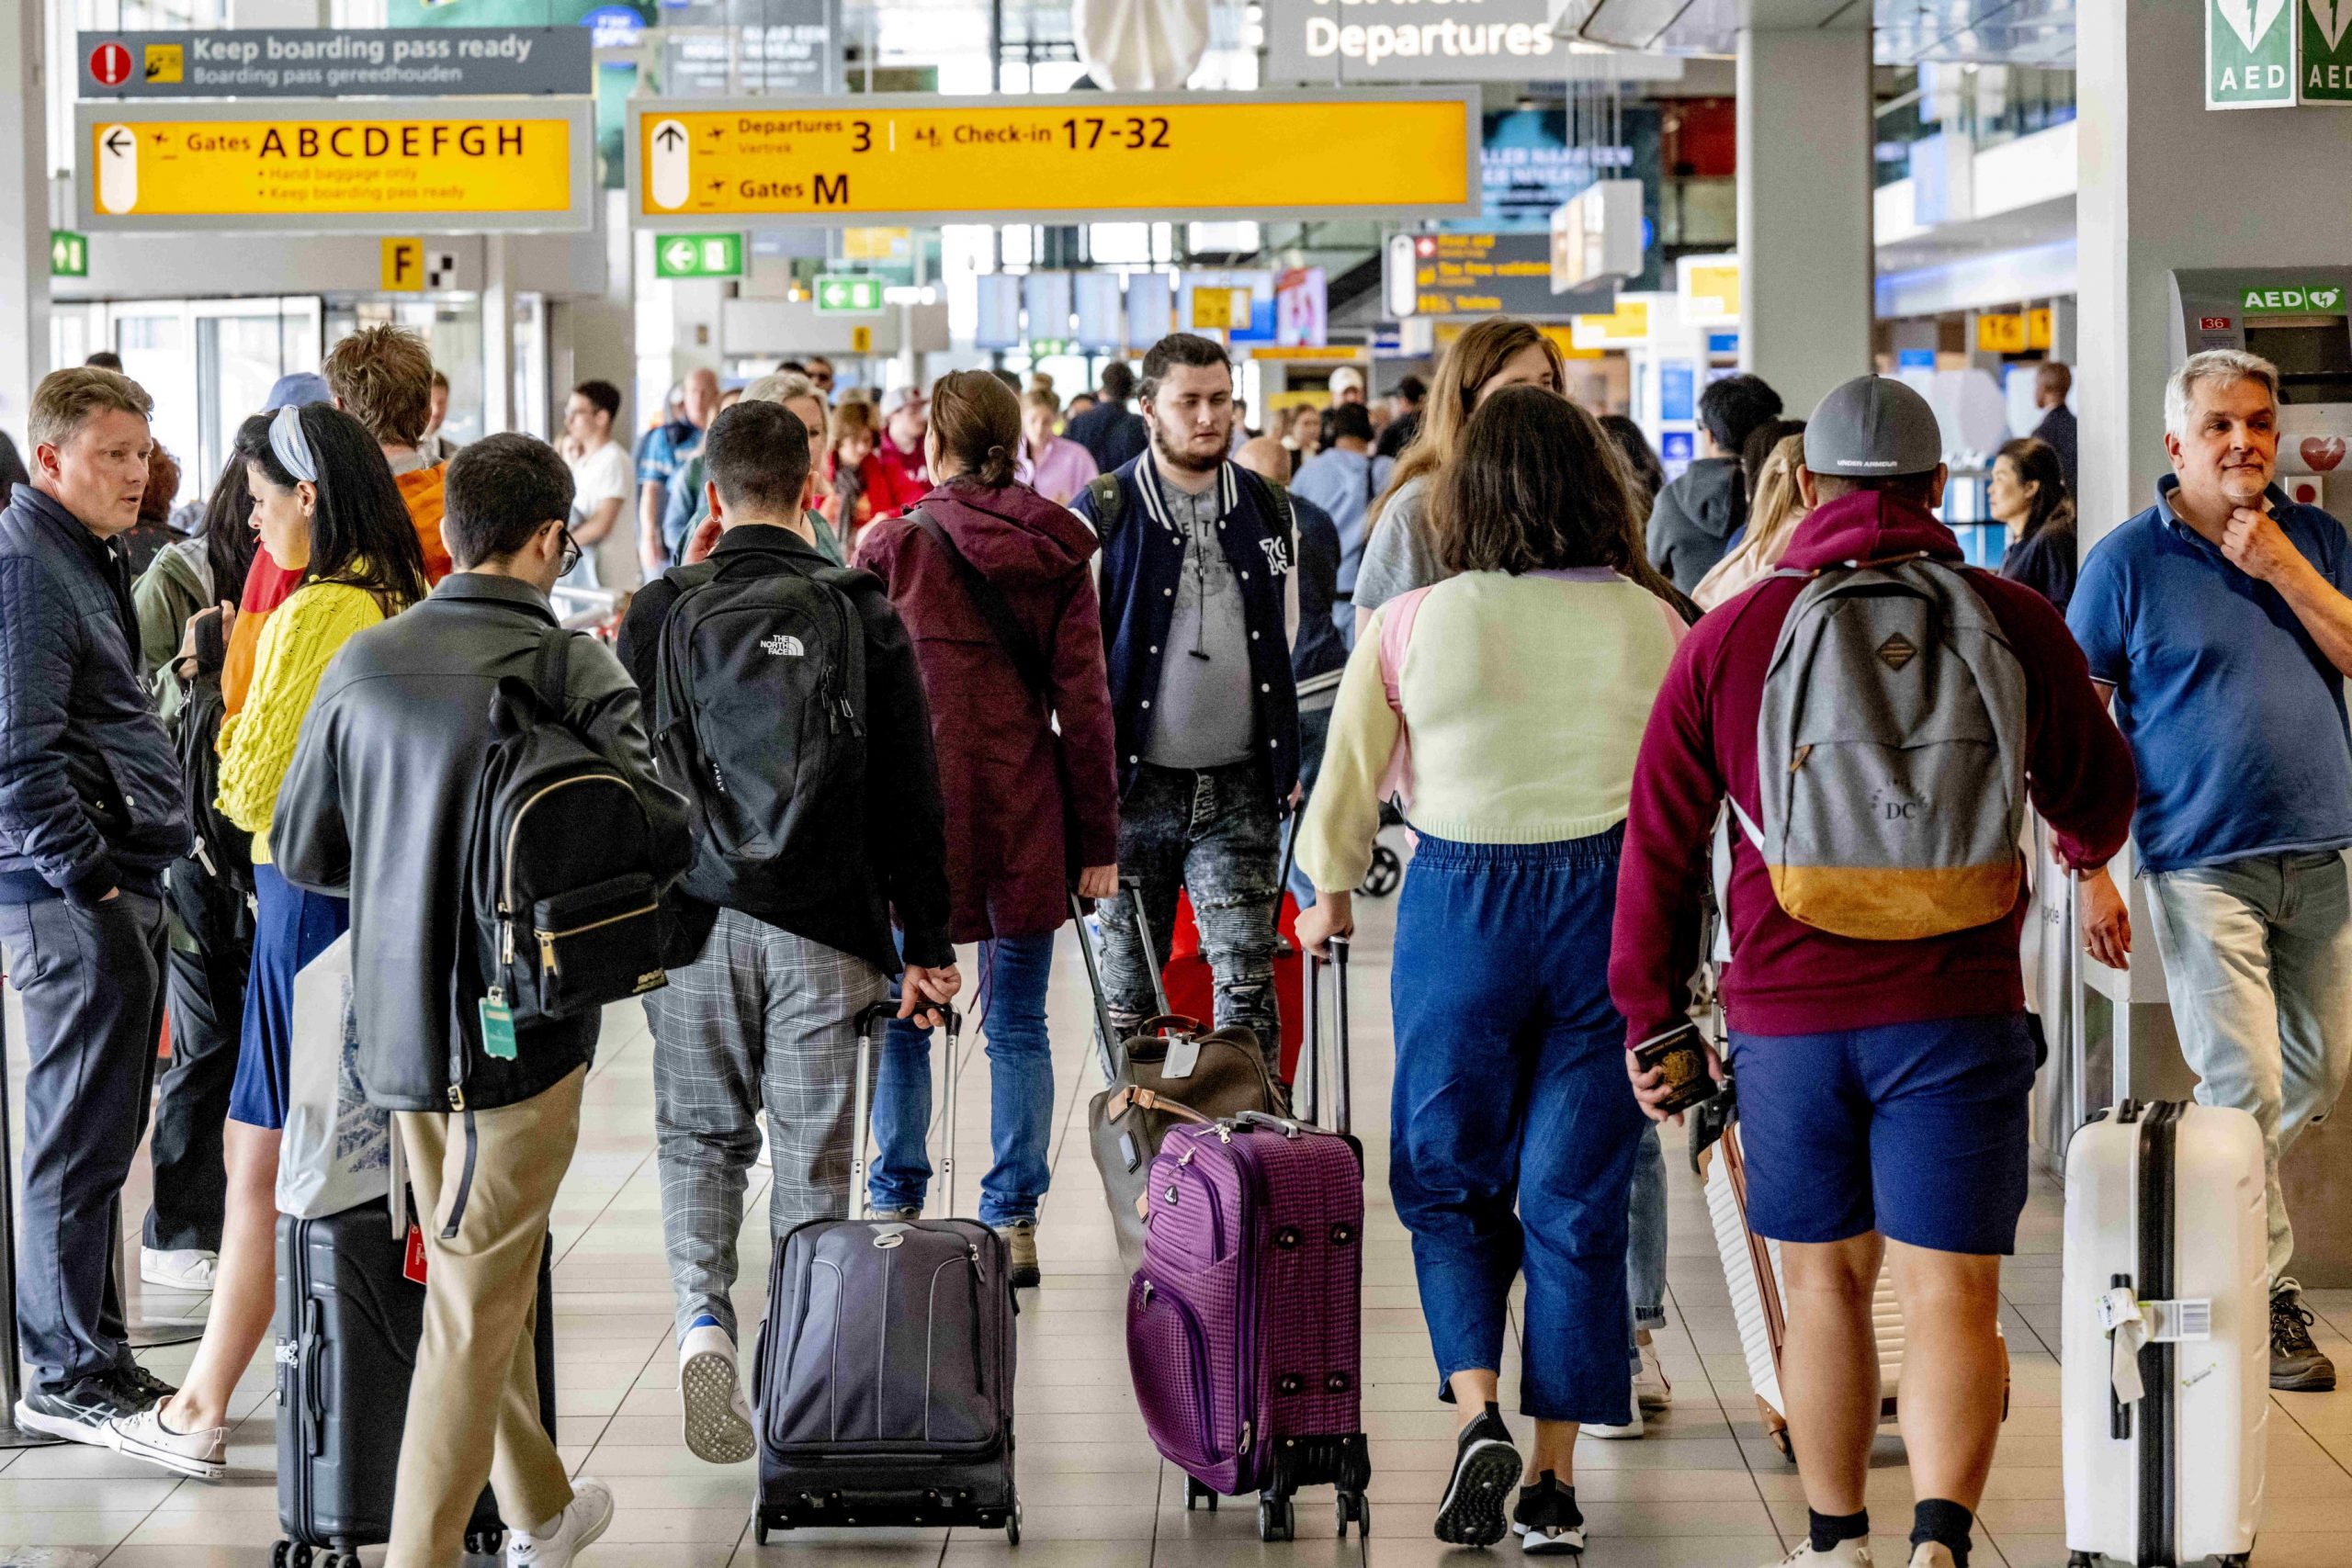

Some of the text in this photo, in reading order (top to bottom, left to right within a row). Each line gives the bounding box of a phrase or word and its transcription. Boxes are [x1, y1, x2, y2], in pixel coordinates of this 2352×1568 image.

[193, 33, 533, 64] Keep boarding pass ready
[1305, 17, 1554, 66] Departures
[194, 64, 462, 88] Boarding pass gereedhouden
[2219, 64, 2285, 91] AED
[187, 132, 252, 152] Gates
[737, 118, 871, 152] Departures 3
[953, 117, 1170, 149] Check-in 17-32
[270, 165, 418, 184] Hand baggage only
[270, 185, 466, 204] Keep boarding pass ready
[740, 174, 848, 205] Gates M
[395, 245, 412, 283] F
[2245, 291, 2303, 309] AED
[2205, 318, 2224, 329] 36
[1838, 459, 1863, 468] UNDER
[760, 640, 788, 649] NORTH
[773, 634, 789, 643] THE
[768, 648, 788, 656] FACE
[712, 762, 725, 792] VAULT
[1885, 802, 1917, 819] DC
